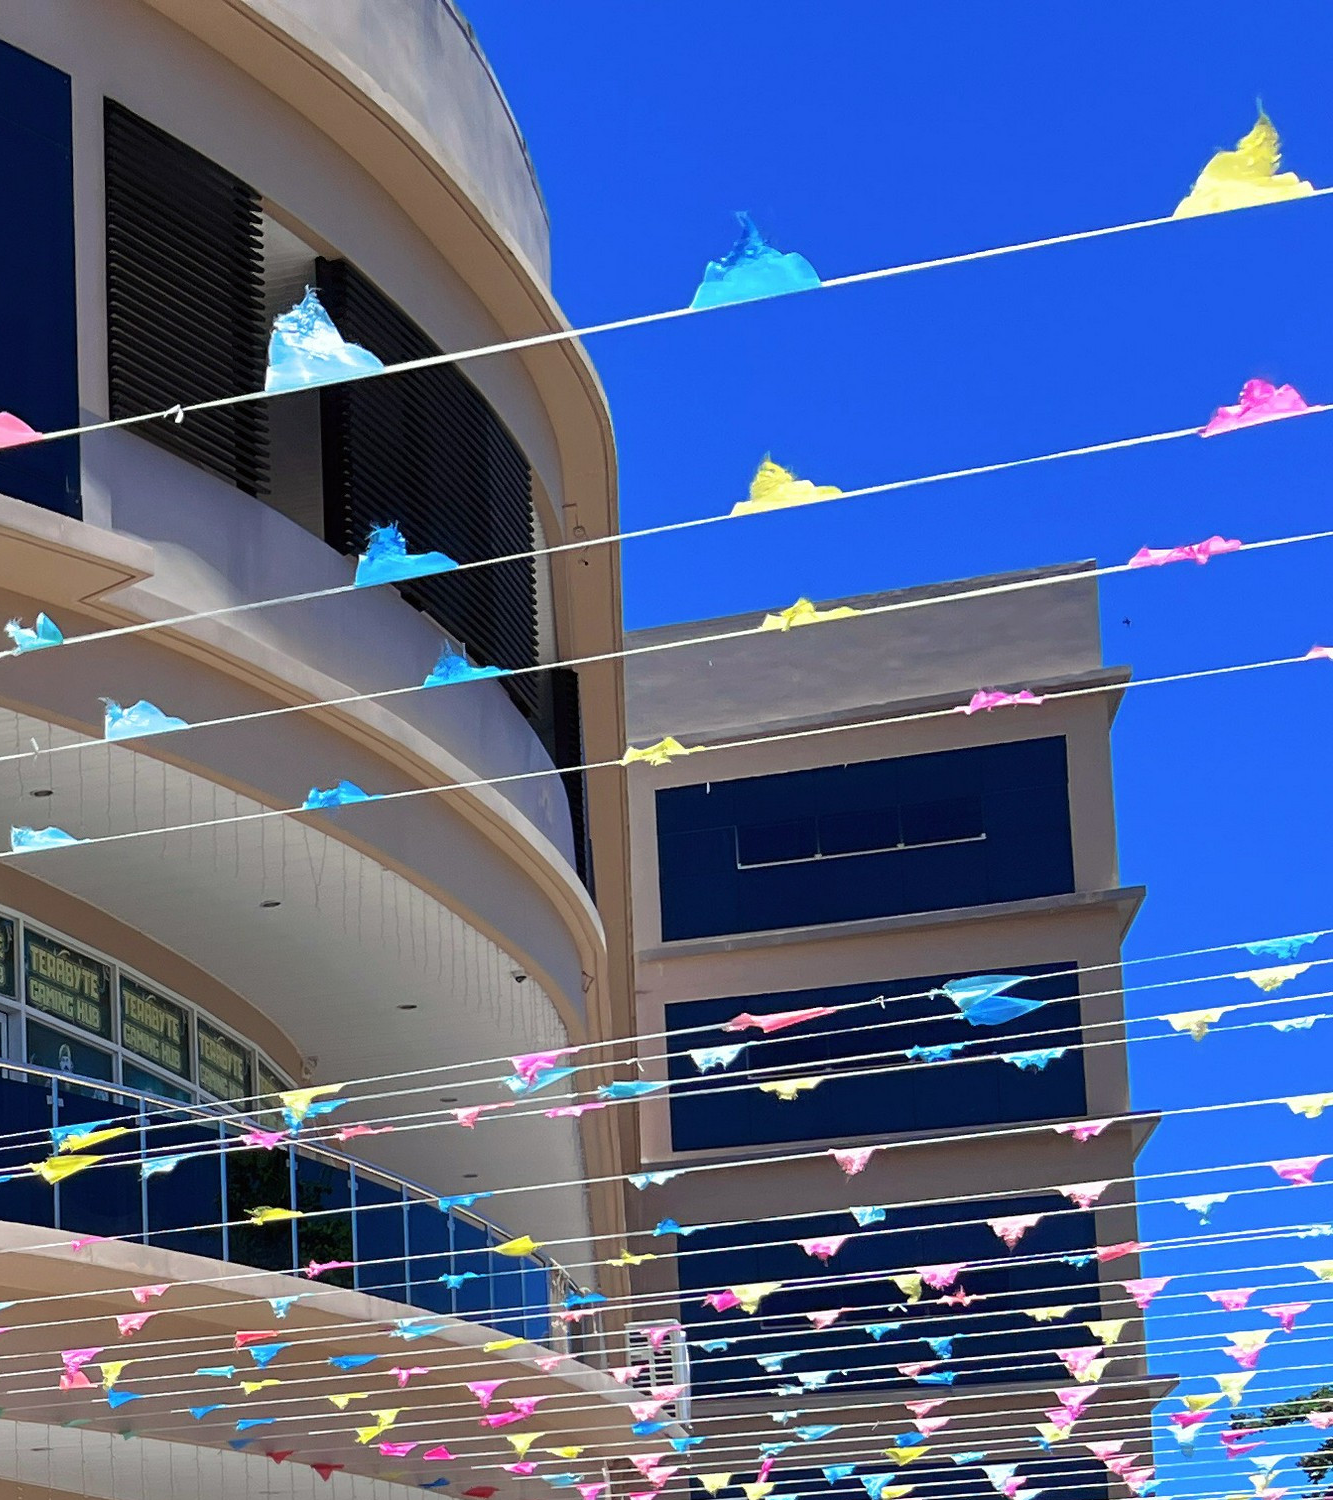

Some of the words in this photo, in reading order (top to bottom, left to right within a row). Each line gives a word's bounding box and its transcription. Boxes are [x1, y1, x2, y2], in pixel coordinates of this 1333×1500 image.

[29, 944, 100, 1000] TERABYTE
[29, 978, 75, 1018] GAMING
[77, 998, 101, 1029] HUB
[123, 990, 182, 1045] TERABYTE
